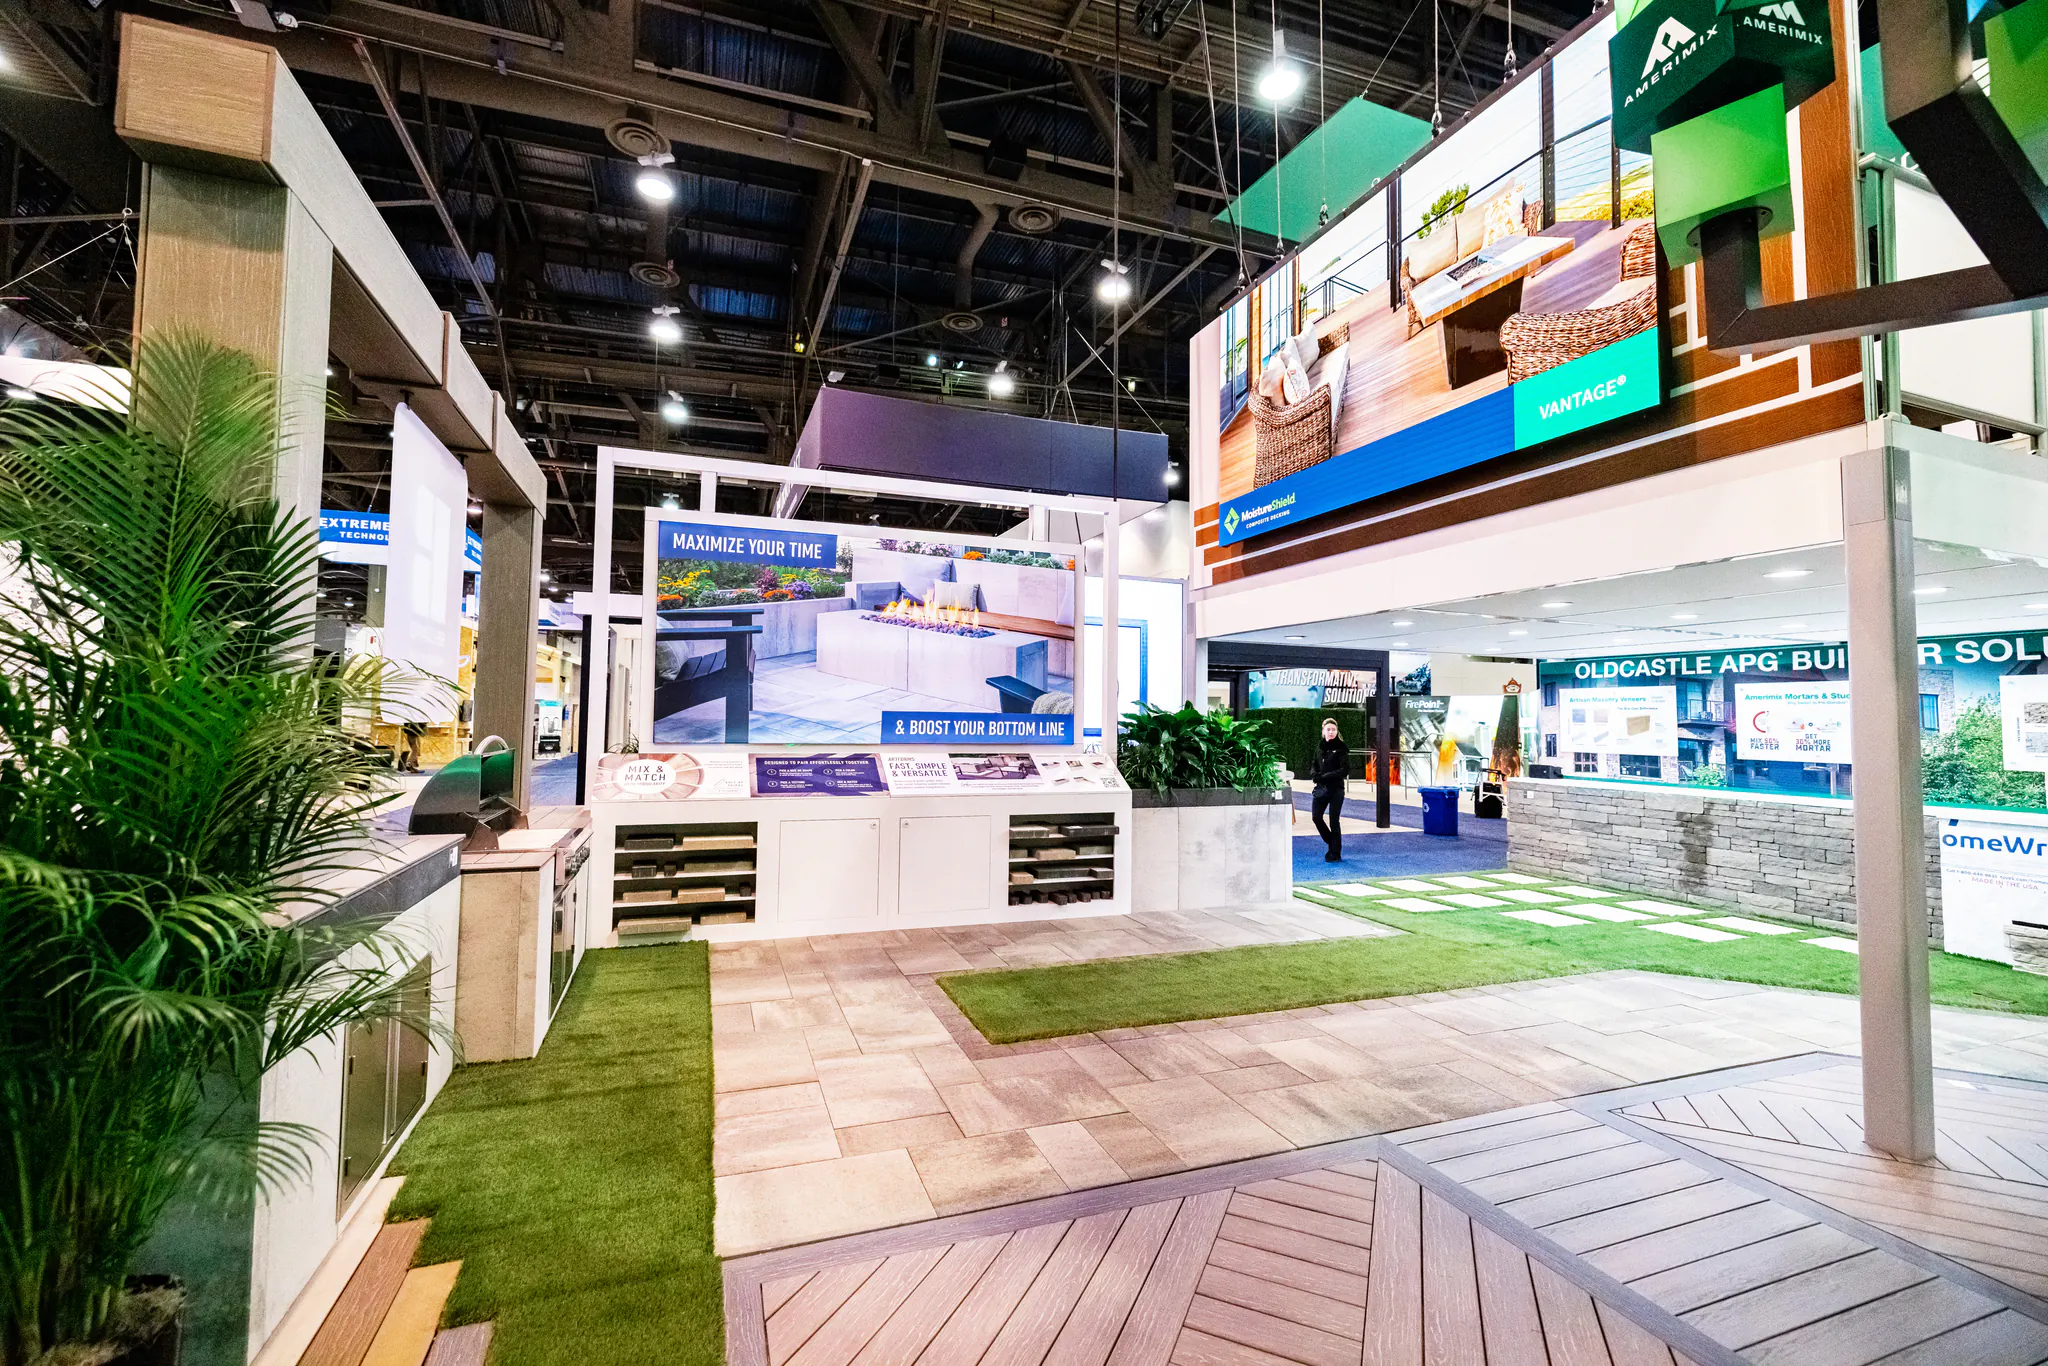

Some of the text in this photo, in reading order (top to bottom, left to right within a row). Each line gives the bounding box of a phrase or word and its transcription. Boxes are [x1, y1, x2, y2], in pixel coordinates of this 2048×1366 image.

[1744, 16, 1823, 45] AMERIMIX
[1624, 24, 1718, 108] AMERIMIX
[1241, 492, 1296, 522] MoistureShield
[1246, 510, 1290, 528] COMPOSITE DECKING
[319, 518, 390, 530] EXTREME
[673, 532, 822, 559] MAXIMIZE YOUR TIME
[1575, 656, 1712, 679] OLDCASTLE
[1955, 636, 2048, 664] SOL
[1276, 670, 1358, 686] TRANSFORMATIVE
[895, 720, 1065, 736] & BOOST YOUR BOTTOM LINE
